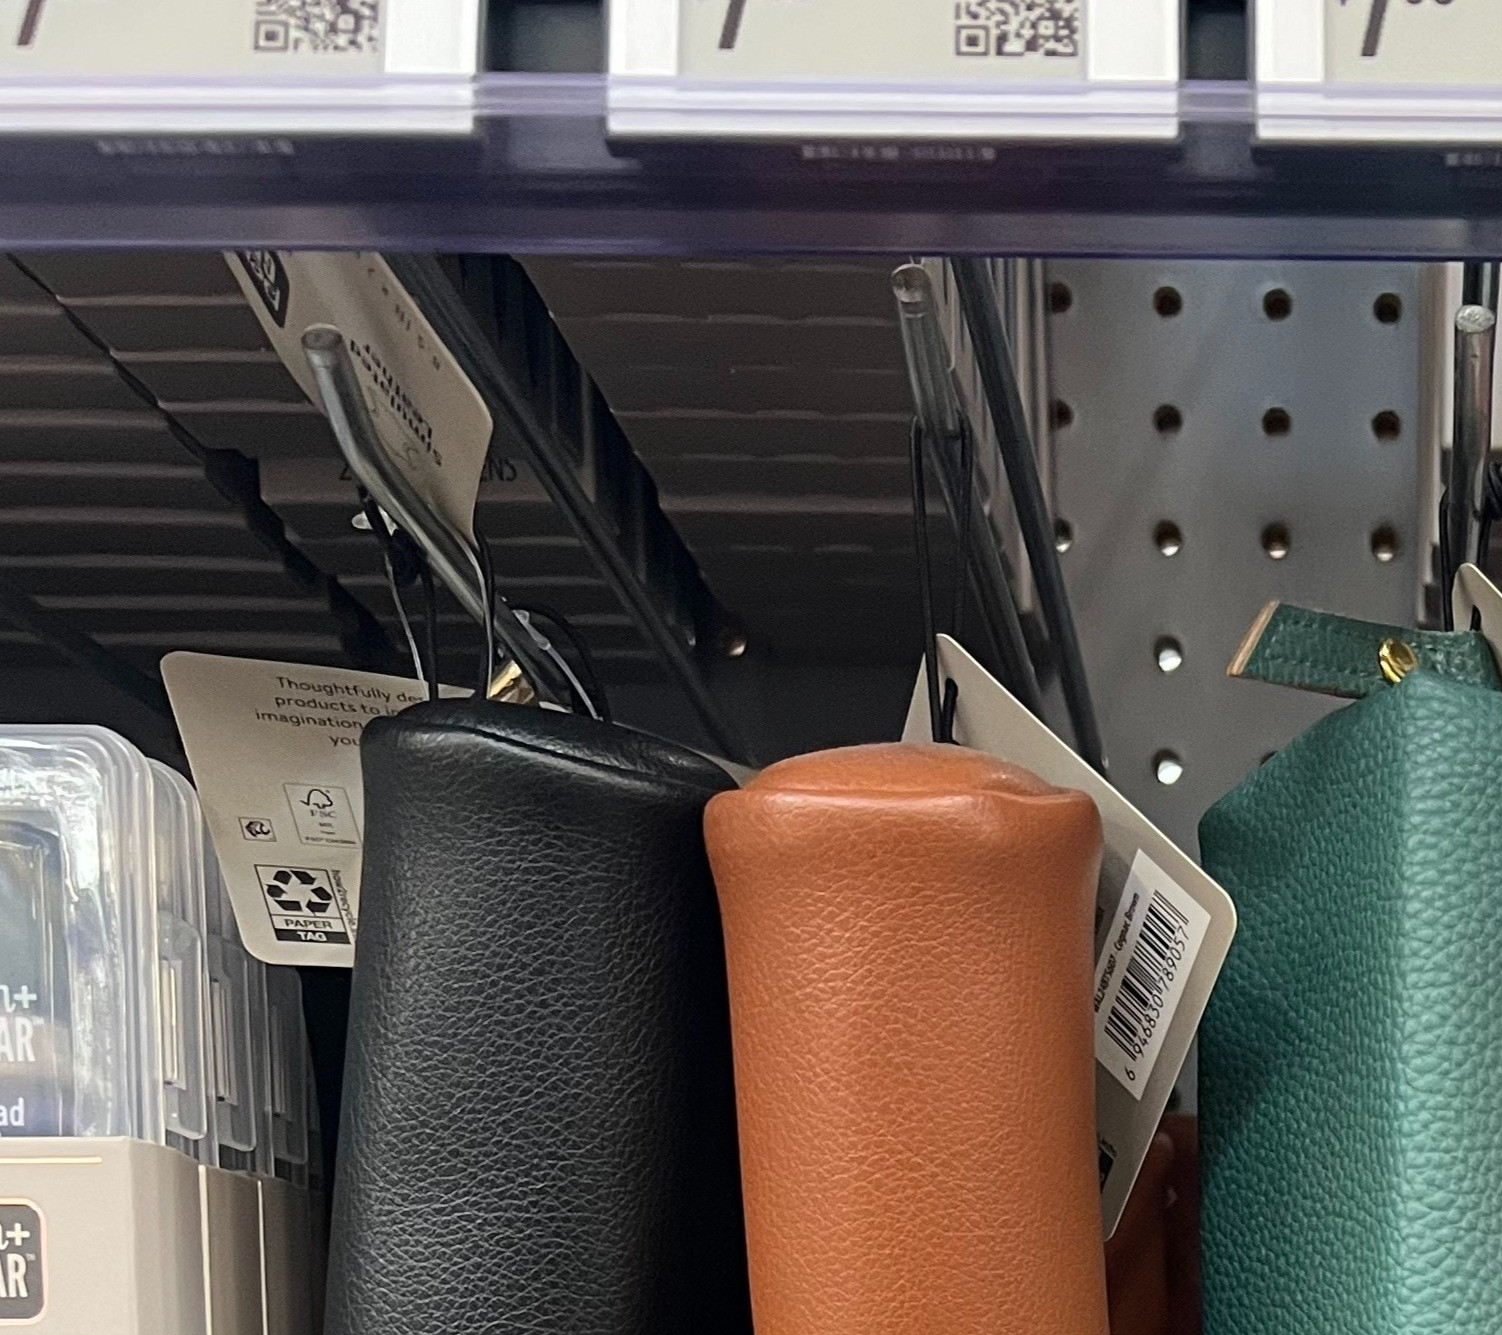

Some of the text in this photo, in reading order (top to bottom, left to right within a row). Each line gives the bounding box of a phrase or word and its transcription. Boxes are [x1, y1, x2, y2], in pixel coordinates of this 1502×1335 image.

[276, 676, 391, 704] Thoughtfully
[275, 697, 356, 713] products
[361, 703, 380, 715] to
[284, 918, 333, 930] PAPER
[1114, 918, 1131, 952] Cognac
[1125, 892, 1140, 919] Brown
[297, 929, 328, 942] TAG
[1124, 925, 1189, 1082] 6 946830 789057
